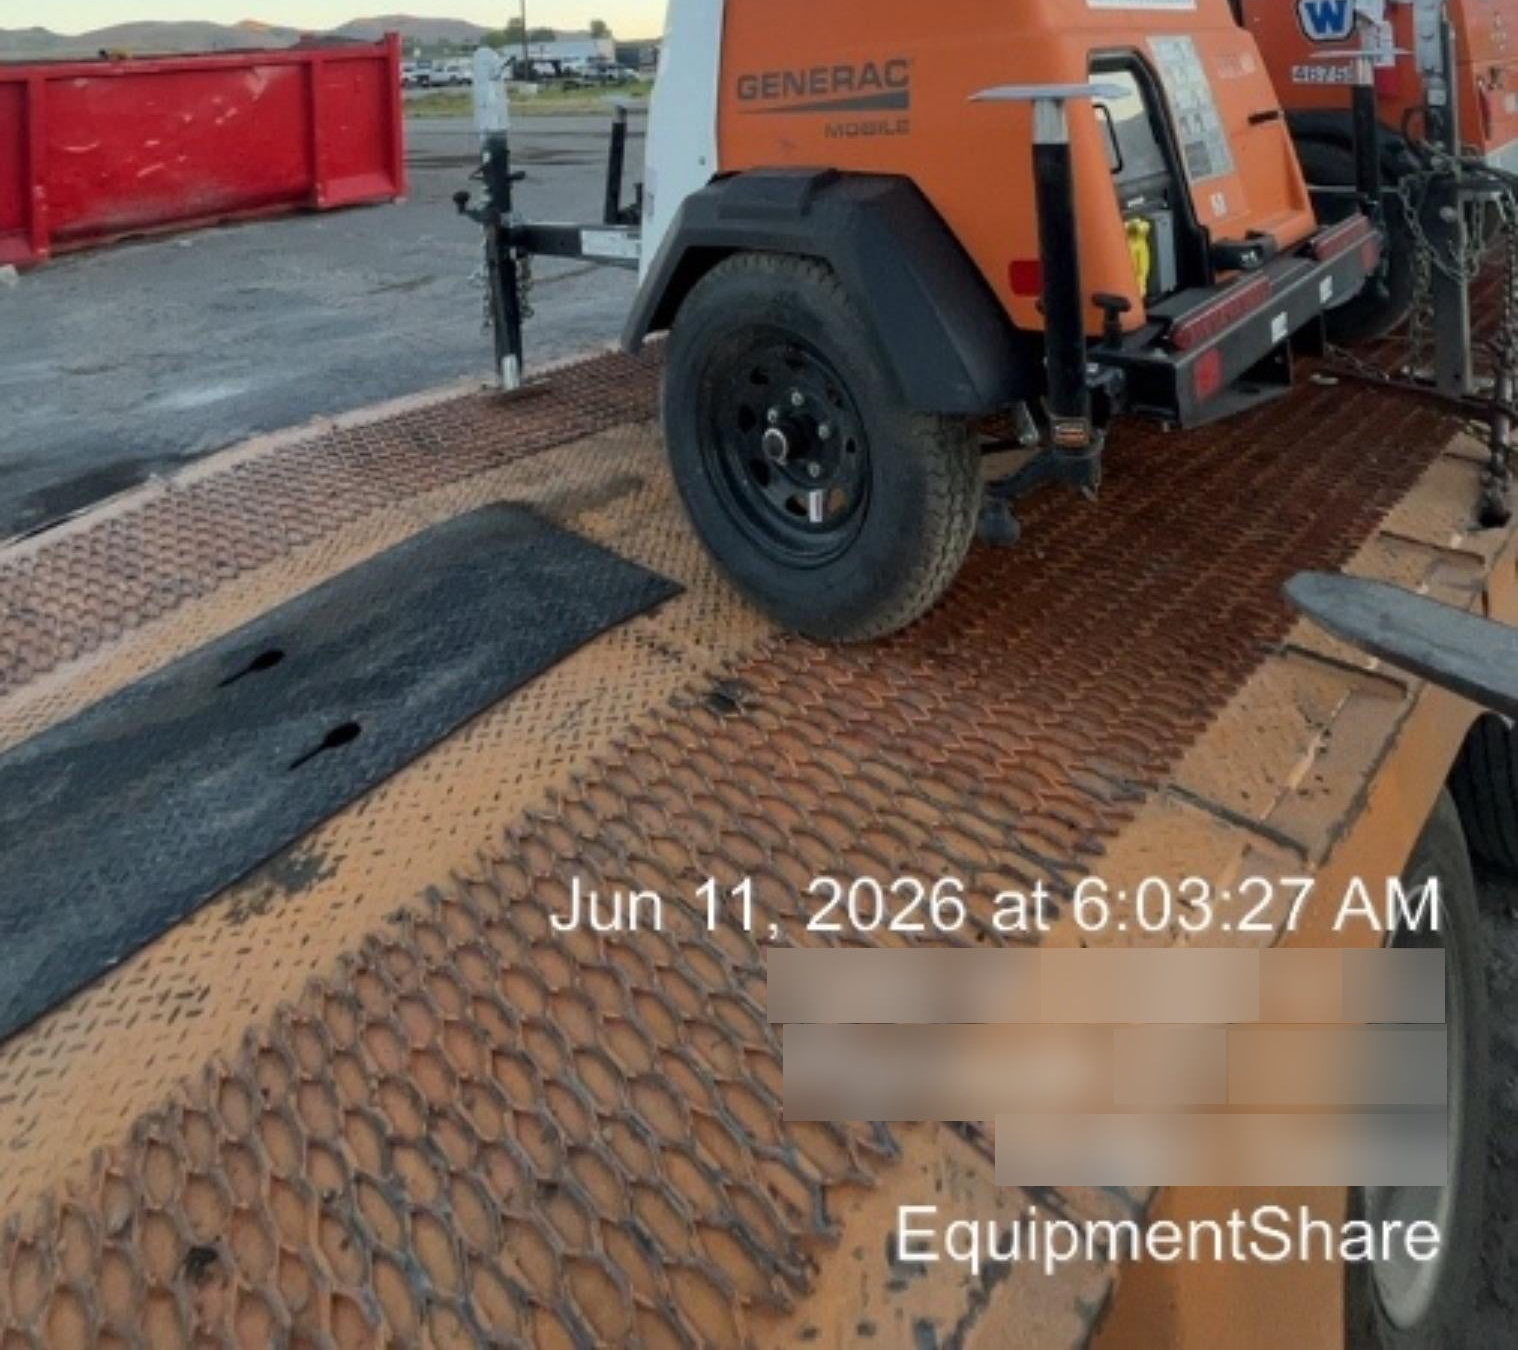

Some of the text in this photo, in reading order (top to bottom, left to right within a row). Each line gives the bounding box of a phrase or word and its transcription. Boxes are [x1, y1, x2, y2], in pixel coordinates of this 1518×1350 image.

[1304, 0, 1348, 34] W
[737, 59, 909, 100] GENERAC
[824, 119, 910, 138] MOBILE
